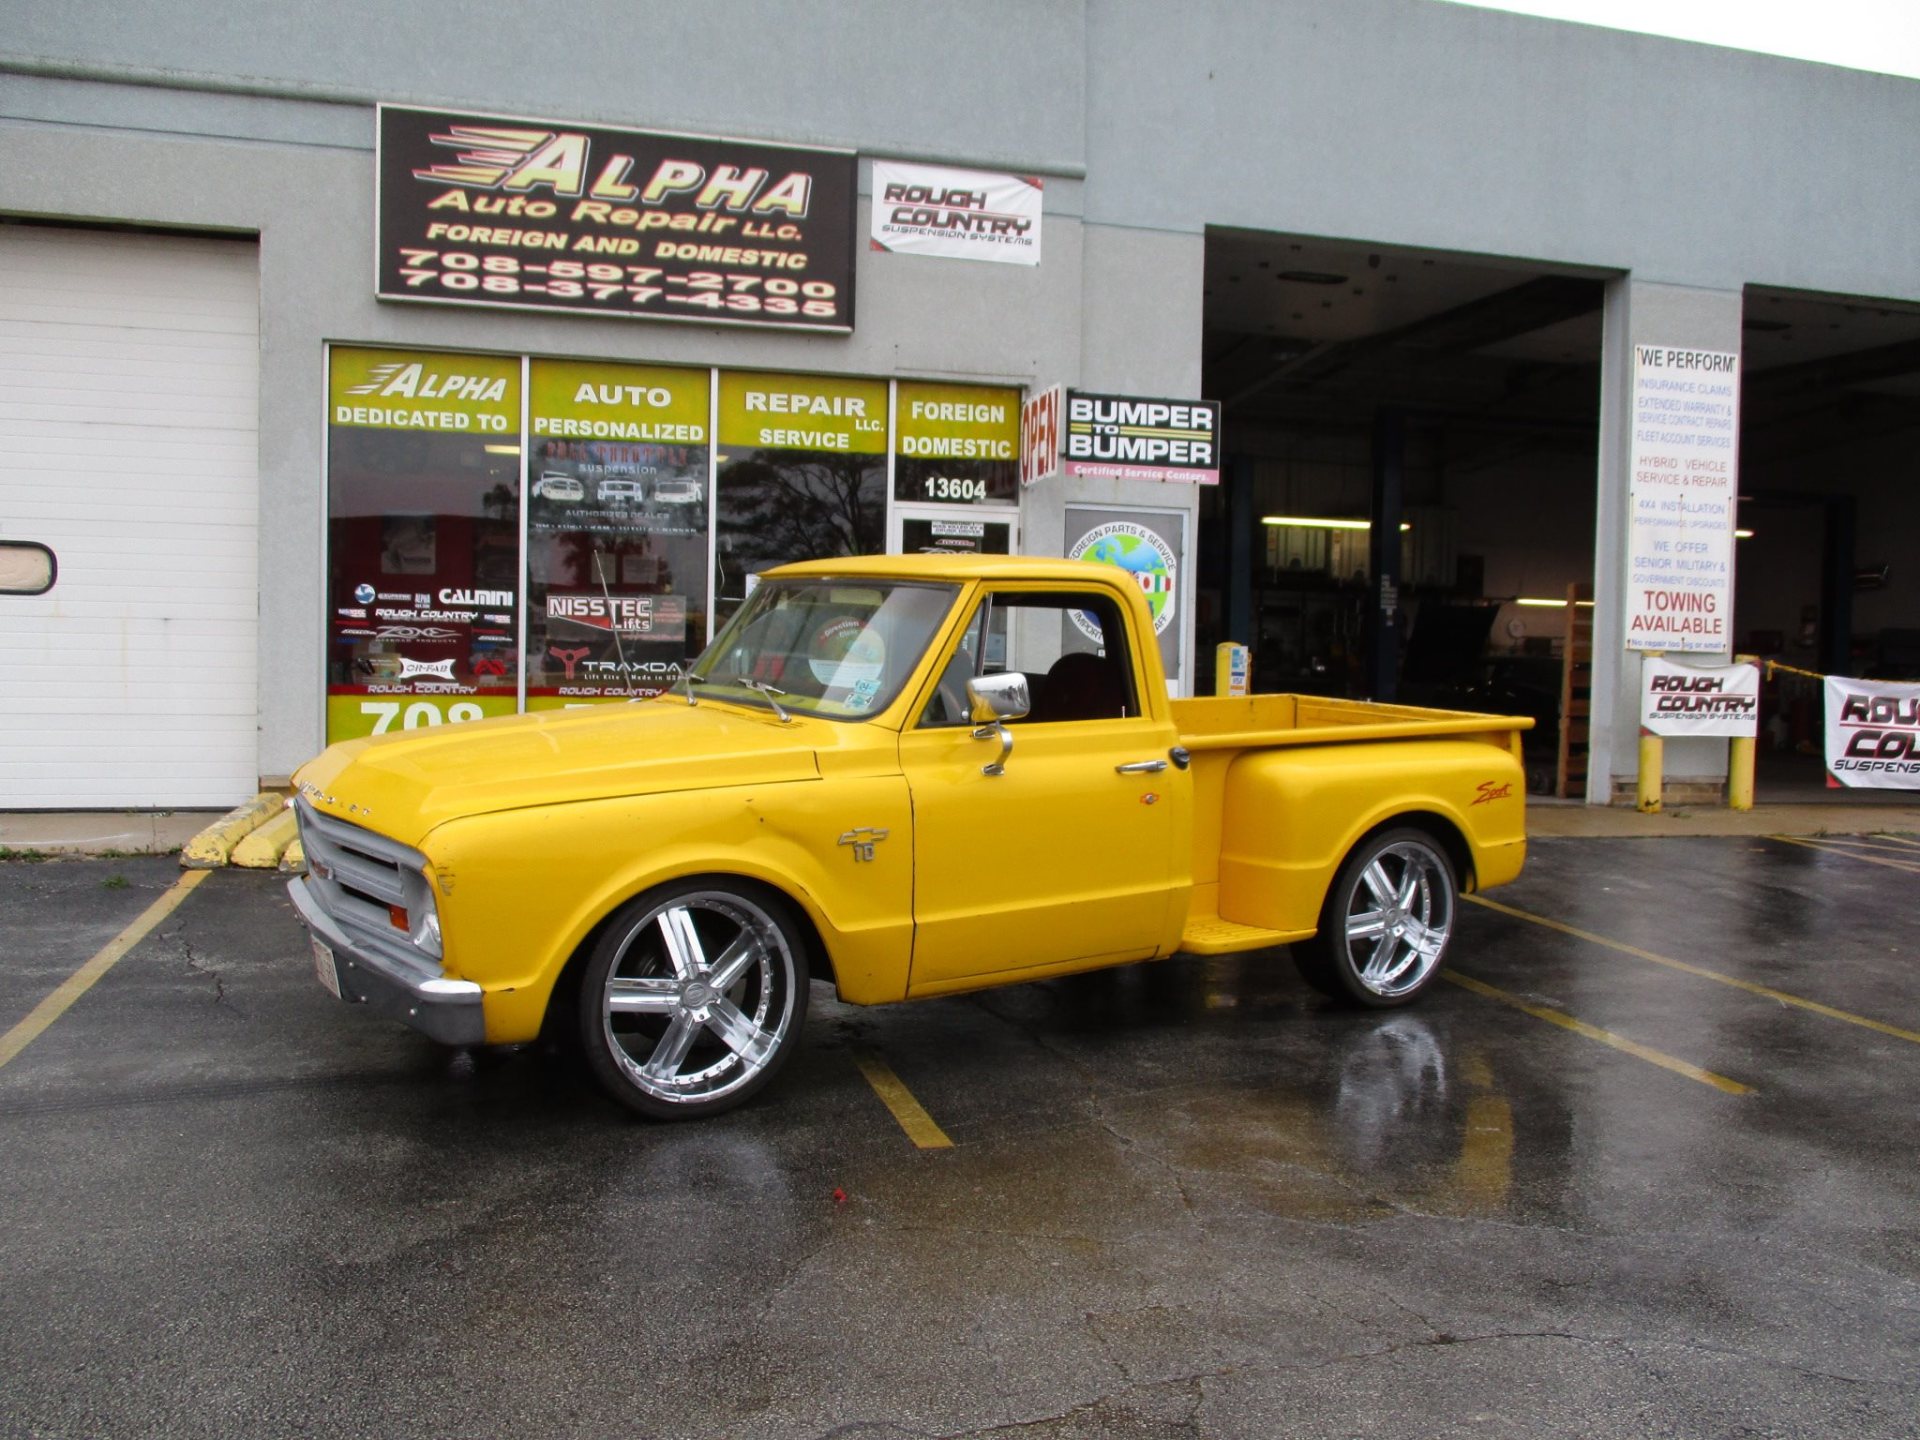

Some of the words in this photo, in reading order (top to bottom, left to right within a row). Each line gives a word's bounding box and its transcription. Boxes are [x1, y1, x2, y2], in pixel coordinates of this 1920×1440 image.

[503, 133, 812, 218] ALPHA
[884, 182, 987, 210] ROUGH
[428, 189, 556, 219] Auto
[571, 200, 737, 233] Repair
[741, 221, 803, 241] LLC.
[890, 206, 1032, 236] COUNTRY
[426, 223, 568, 250] FOREIGN
[572, 234, 640, 256] AND
[655, 241, 807, 269] DOMESTIC
[882, 224, 966, 240] SUSPENSION
[969, 232, 1033, 246] SYSTEMS
[400, 247, 836, 298] 708-597-2700
[400, 268, 837, 318] 708-377-4335
[1640, 348, 1662, 367] WE
[1667, 351, 1733, 373] PERFORM
[381, 363, 507, 401] ALPHA
[1638, 378, 1696, 393] INSURANCE
[1697, 384, 1732, 397] CLAIMS
[574, 383, 672, 407] AUTO
[1638, 397, 1681, 412] EXTENDED
[336, 405, 469, 429] DEDICATED
[477, 413, 507, 431] TO
[745, 392, 866, 417] REPAIR
[855, 419, 884, 432] LLC.
[912, 401, 1005, 423] FOREIGN
[1070, 398, 1213, 430] BUMPER
[534, 417, 704, 441] PERSONALIZED
[760, 428, 849, 449] SERVICE
[1021, 387, 1060, 483] OPEN
[1093, 423, 1119, 435] TO
[1637, 430, 1660, 442] FLEET
[903, 436, 1011, 458] DOMESTIC
[1069, 434, 1212, 464] BUMPER
[1074, 465, 1122, 477] Certified
[1124, 468, 1165, 479] Service
[1639, 456, 1678, 468] HYBRID
[1684, 459, 1727, 472] VEHICLE
[925, 477, 987, 499] 13604
[1636, 471, 1680, 485] SERVICE
[1683, 476, 1688, 486] &
[1692, 475, 1728, 487] REPAIR
[1661, 500, 1725, 514] INSTALLATION
[1105, 524, 1137, 535] PARTS
[1139, 530, 1145, 538] &
[1147, 534, 1176, 570] SERVICE
[1654, 541, 1671, 552] WE
[1675, 542, 1708, 553] OFFER
[1635, 557, 1672, 568] SENIOR
[439, 588, 513, 606] CALMINI
[549, 598, 650, 617] NISSTEC
[1644, 591, 1716, 613] TOWING
[375, 608, 417, 617] ROUGH
[421, 609, 478, 620] COUNTRY
[610, 618, 650, 630] Lifts
[1631, 615, 1722, 634] AVAILABLE
[368, 685, 412, 693] ROUGH
[415, 685, 477, 694] COUNTRY
[559, 687, 601, 695] ROUGH
[604, 687, 662, 696] COUNTRY
[1651, 675, 1723, 692] ROUGH
[1657, 695, 1756, 712] COUNTRY
[1840, 694, 1920, 725] ROU
[1649, 712, 1707, 720] SUSPENSION
[1709, 713, 1756, 721] SYSTEMS
